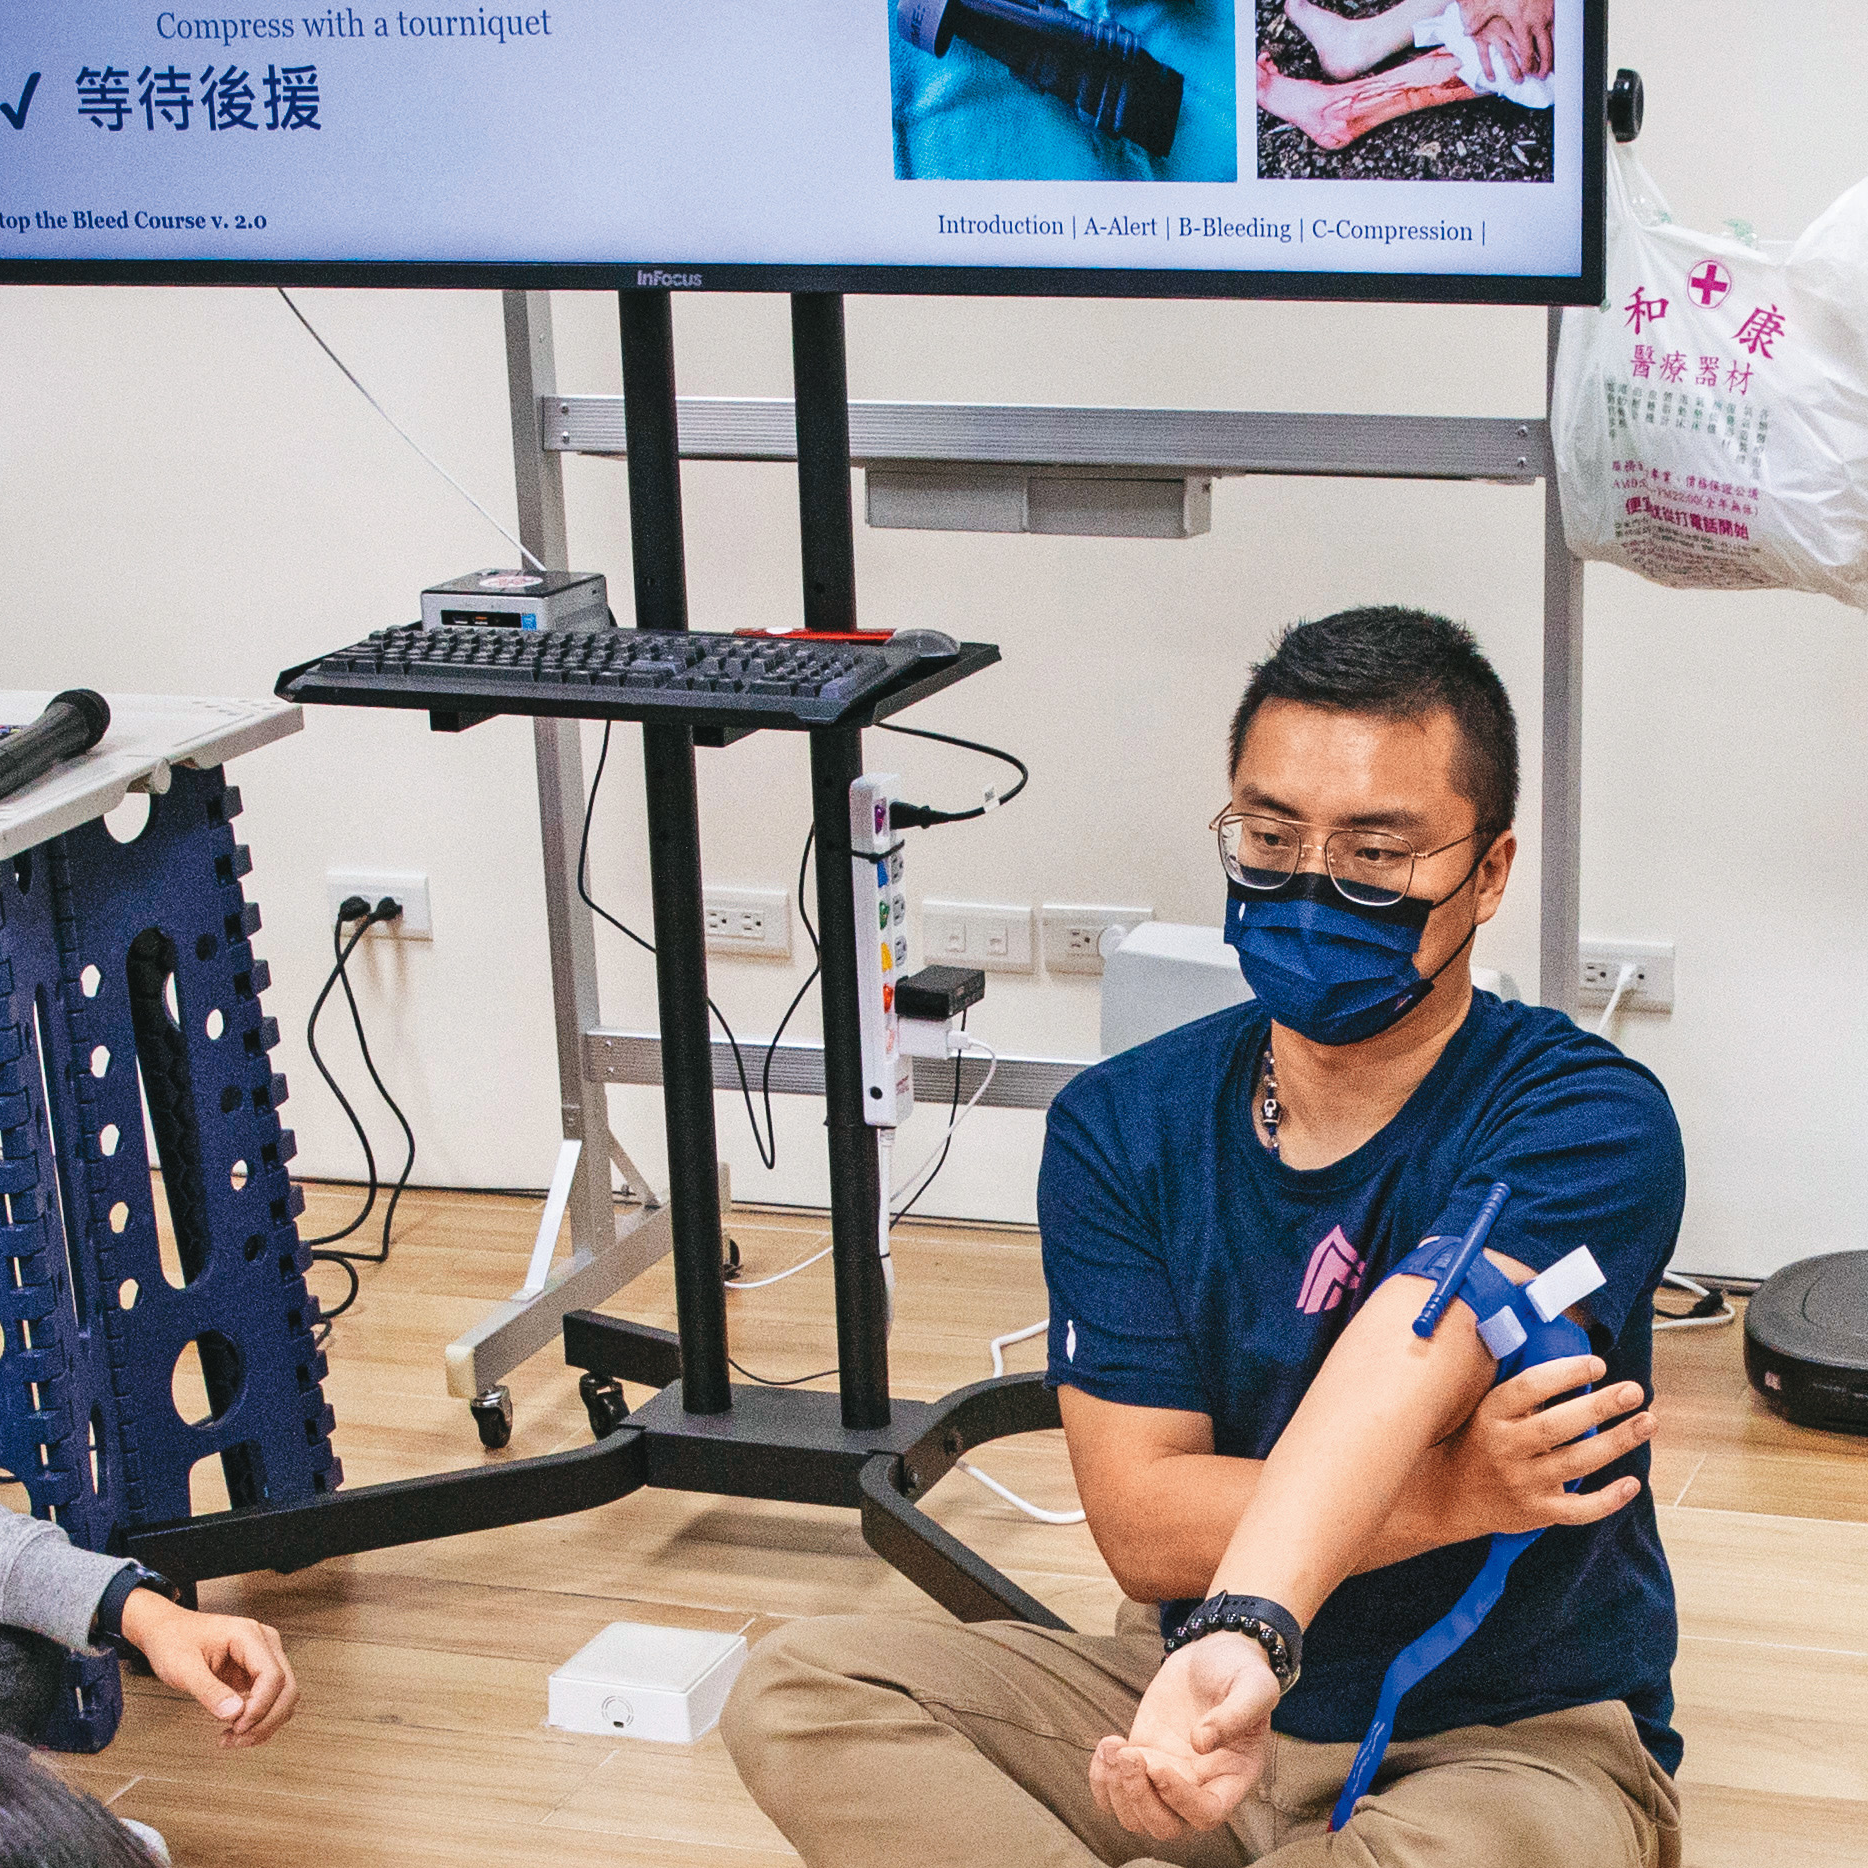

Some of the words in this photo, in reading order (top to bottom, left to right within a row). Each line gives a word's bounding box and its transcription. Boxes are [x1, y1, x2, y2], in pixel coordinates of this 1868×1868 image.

[156, 11, 295, 46] Compress
[302, 8, 365, 38] with
[374, 18, 389, 38] a
[398, 8, 552, 44] tourniquet
[75, 65, 323, 132] 等待後援
[34, 210, 68, 230] the
[72, 210, 130, 230] Bleed
[134, 210, 206, 230] Course
[211, 214, 229, 230] v.
[234, 214, 268, 230] 2.0
[937, 214, 1064, 237] Introduction
[1084, 216, 1158, 237] A-Alert
[1178, 216, 1292, 243] B-Bleeding
[1312, 219, 1473, 246] C-Compression
[637, 269, 702, 287] InFocus
[1623, 285, 1670, 336] 和
[1731, 303, 1786, 360] 康
[1630, 344, 1754, 396] 醫療器材
